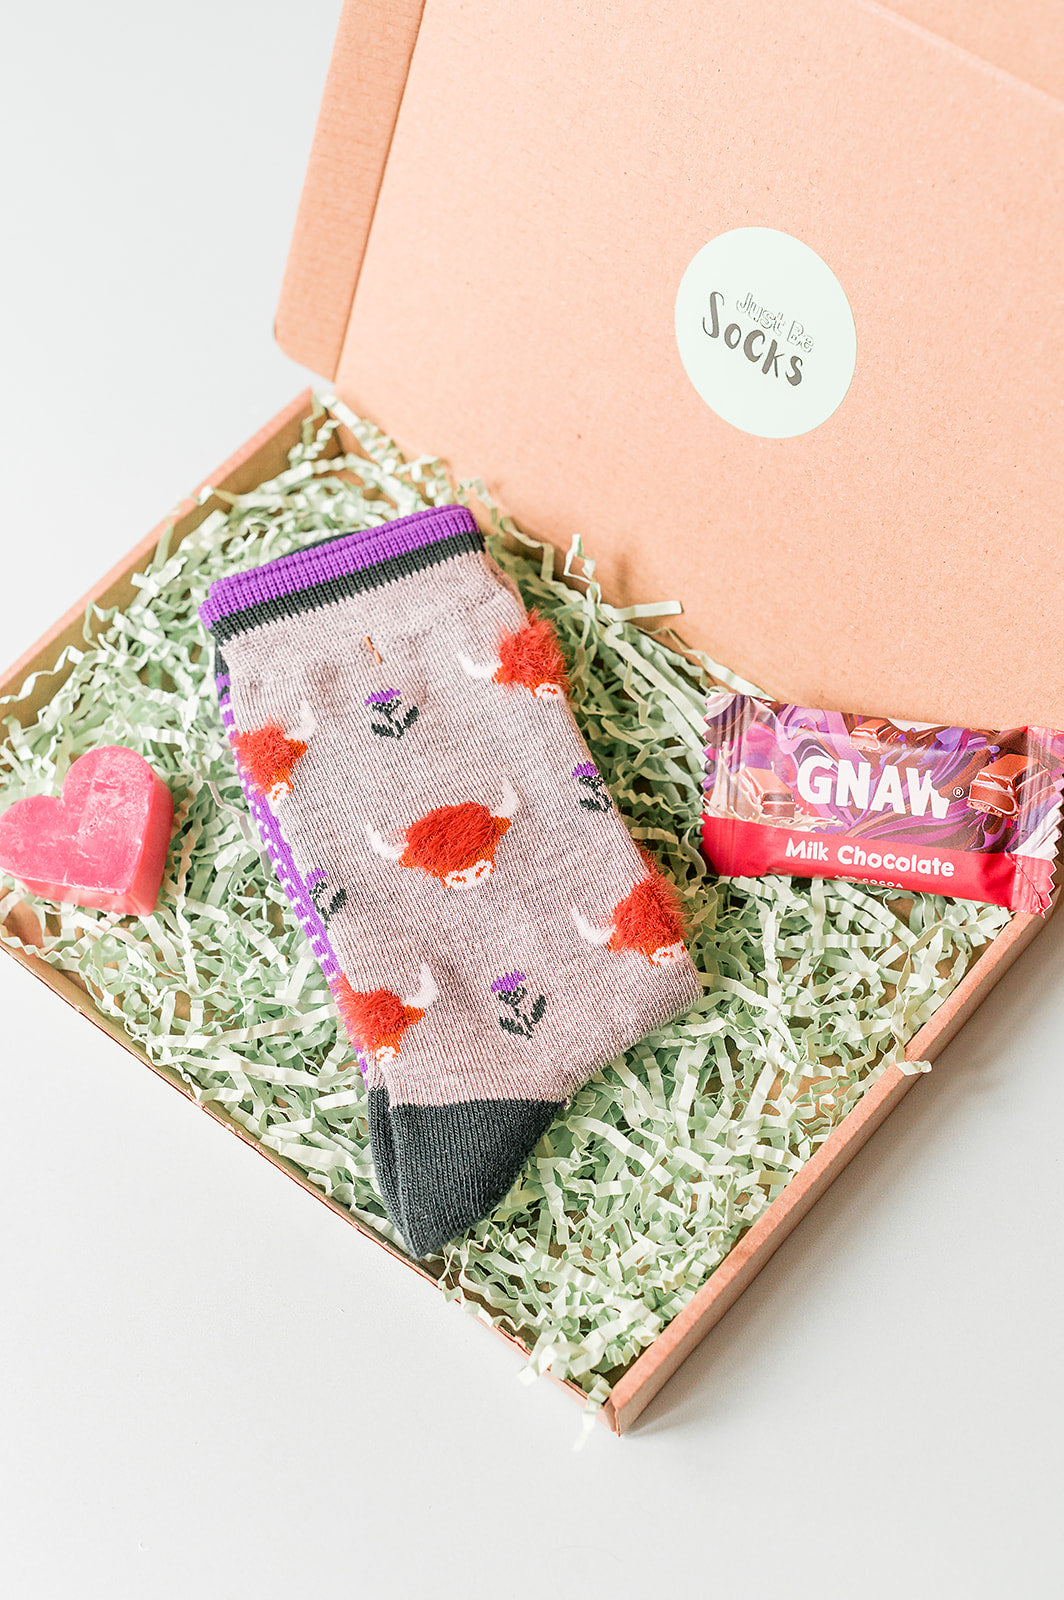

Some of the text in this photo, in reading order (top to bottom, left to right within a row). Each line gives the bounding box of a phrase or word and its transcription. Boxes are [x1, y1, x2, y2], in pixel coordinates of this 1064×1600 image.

[736, 292, 815, 353] Just Be
[797, 755, 950, 819] GNAW
[785, 837, 955, 877] Milk Chocolate
